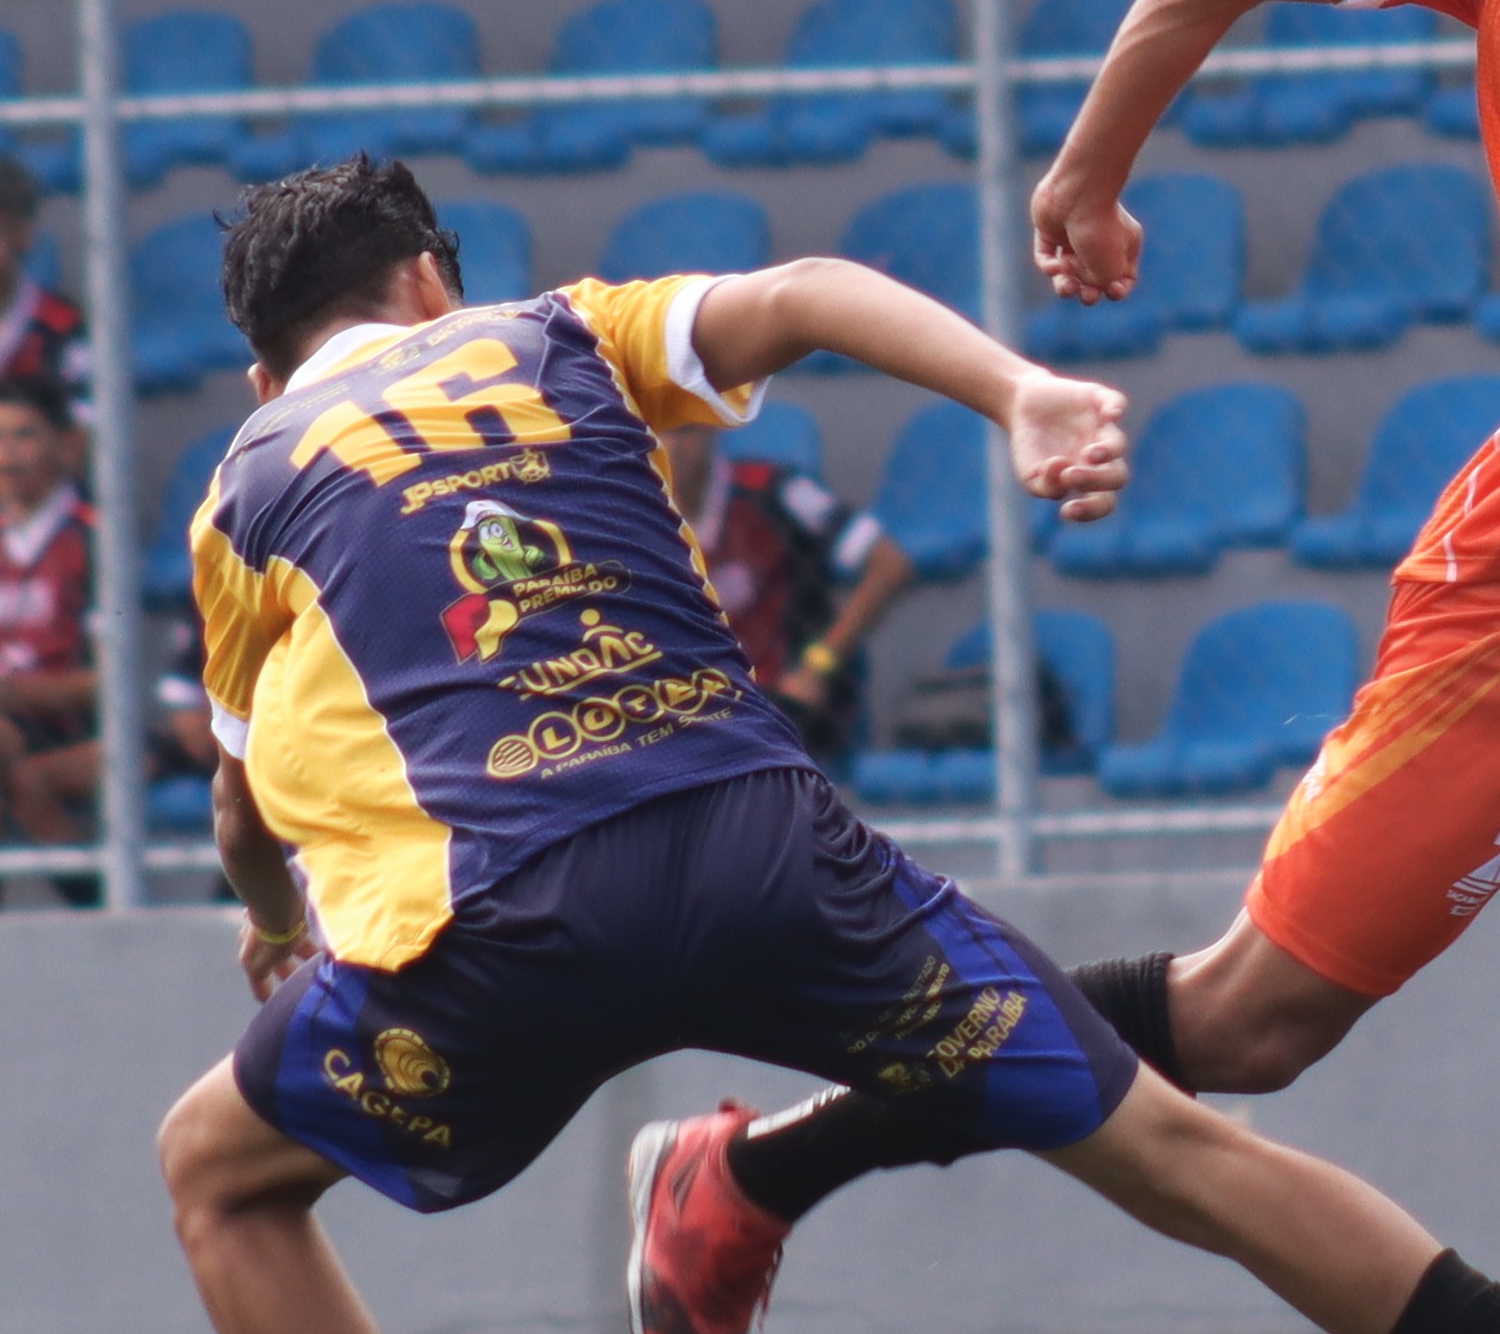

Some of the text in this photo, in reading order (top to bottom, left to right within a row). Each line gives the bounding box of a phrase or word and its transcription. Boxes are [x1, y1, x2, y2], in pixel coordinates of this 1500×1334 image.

[290, 338, 572, 488] 16
[512, 562, 599, 598] PARAÍBA
[636, 722, 675, 748] TEM
[925, 985, 1001, 1060] OVERNO
